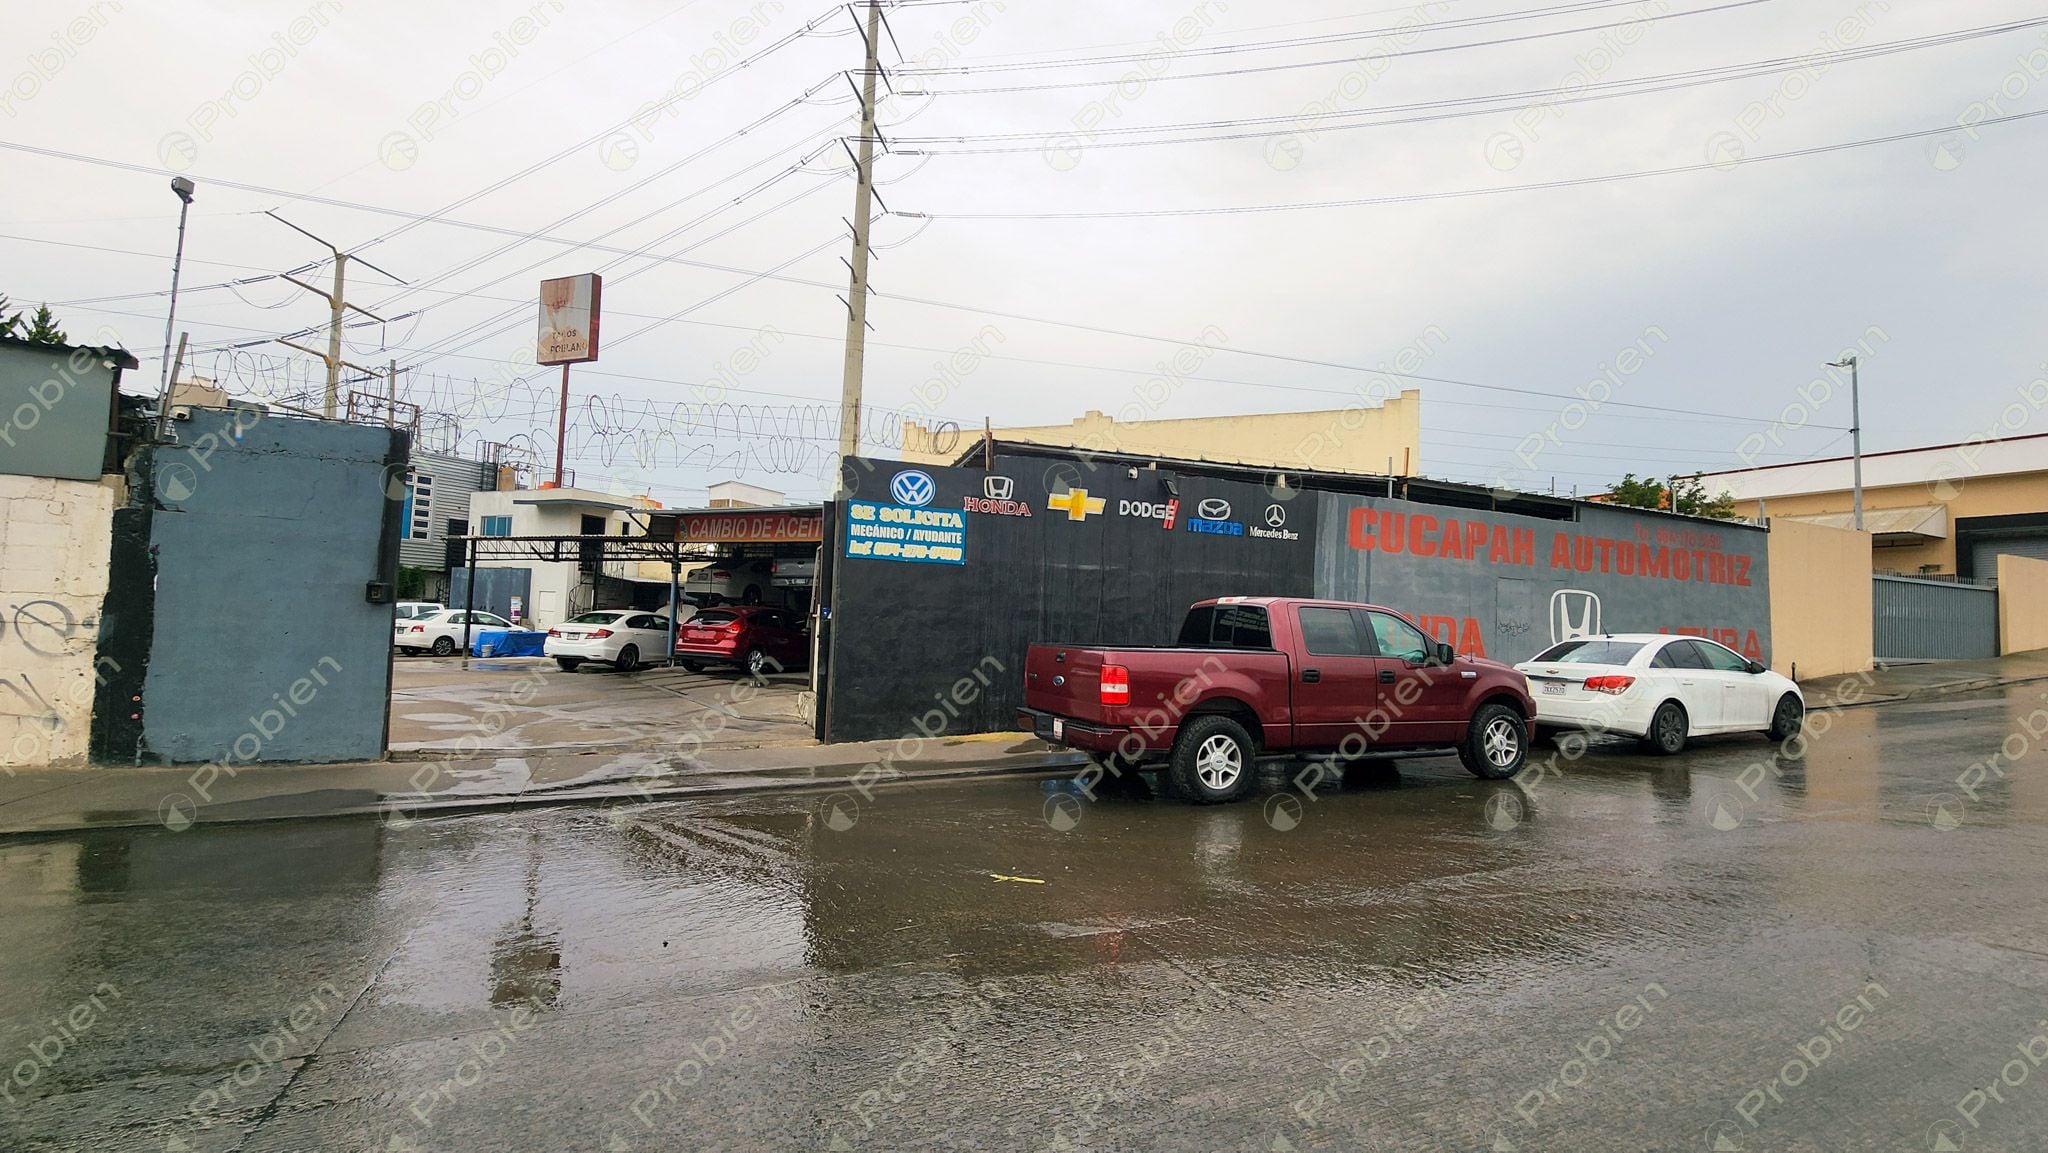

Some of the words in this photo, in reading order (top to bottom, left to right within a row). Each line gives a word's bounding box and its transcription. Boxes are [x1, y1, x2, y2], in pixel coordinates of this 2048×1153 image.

[851, 504, 875, 520] SE
[879, 507, 963, 528] SOLICITA
[964, 496, 1032, 517] HONDA
[1119, 499, 1176, 520] DODGE
[689, 518, 747, 538] CAMBIO
[751, 517, 773, 538] DE
[775, 516, 823, 538] ACEIT
[851, 524, 904, 540] MECÁNICO
[912, 529, 962, 544] AYUDANTE
[1250, 526, 1282, 539] Mercedes
[1282, 529, 1299, 541] Benz
[1348, 507, 1535, 566] CUCAPAH
[1551, 532, 1752, 586] AUTOMOTRIZ
